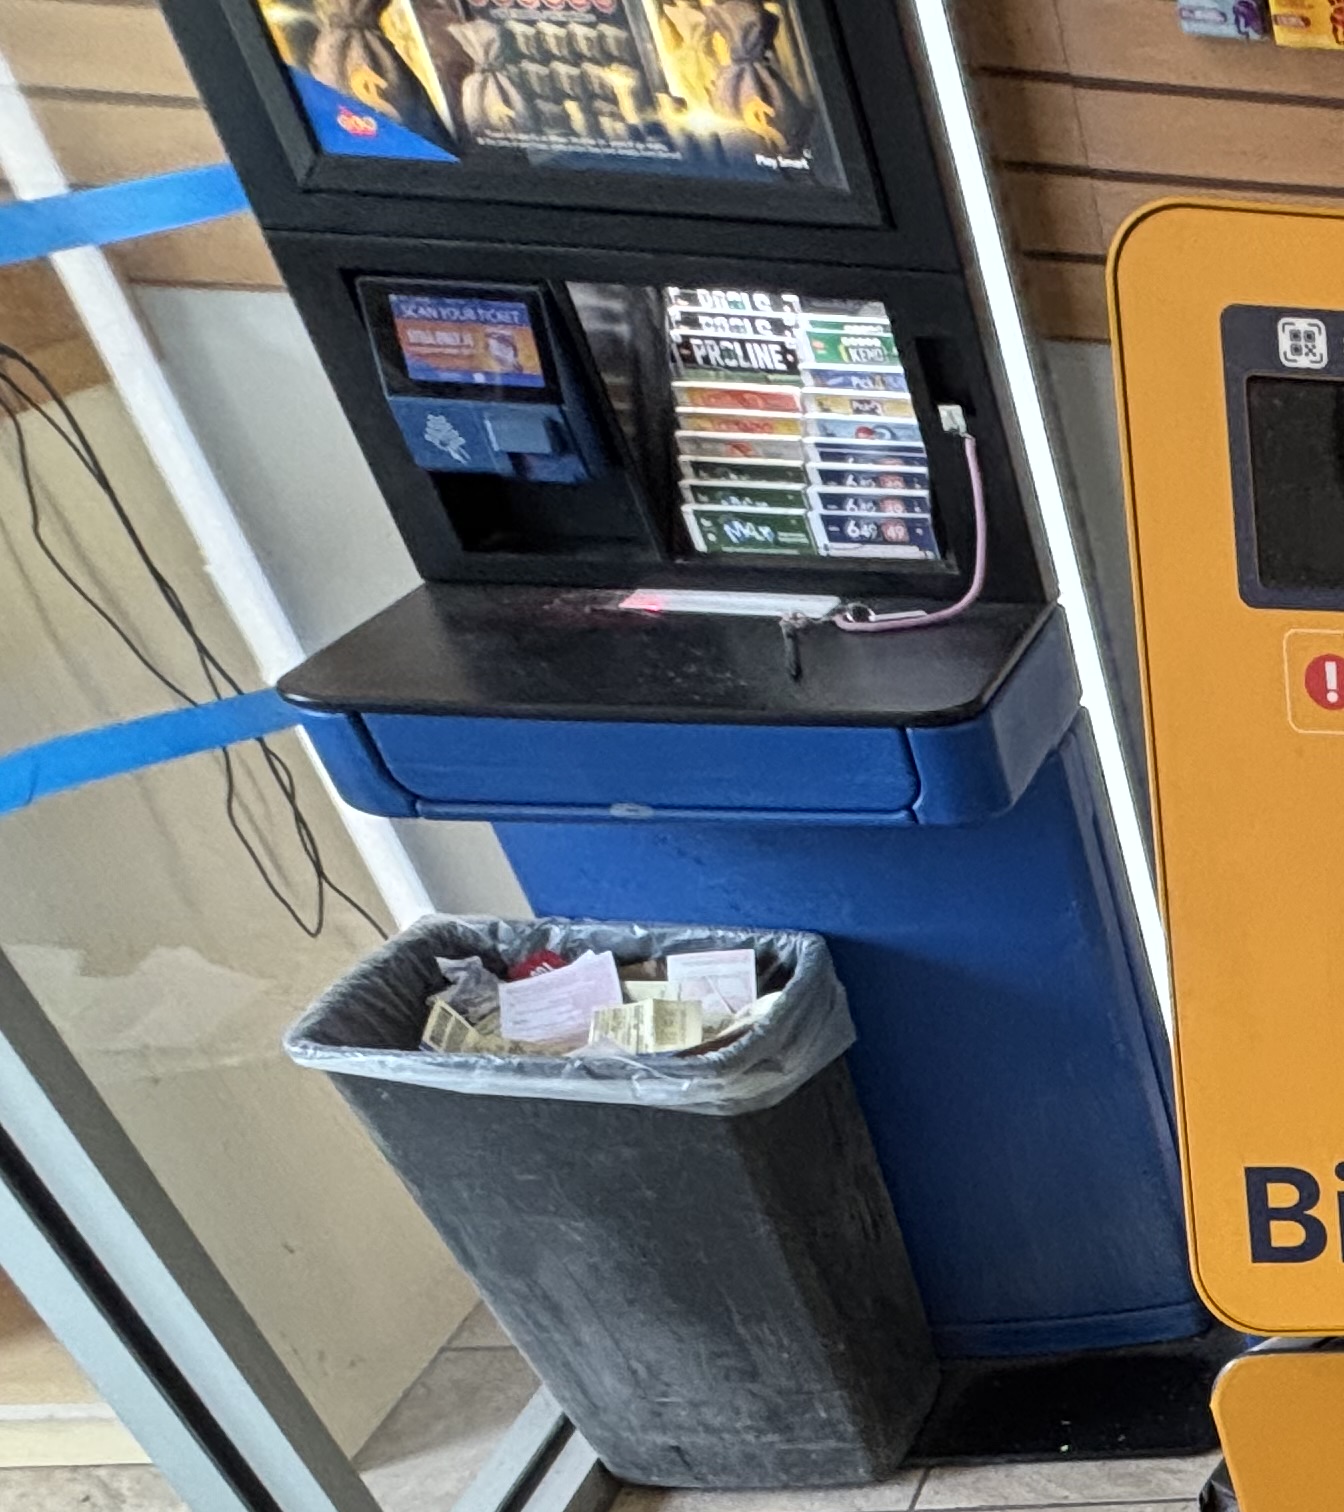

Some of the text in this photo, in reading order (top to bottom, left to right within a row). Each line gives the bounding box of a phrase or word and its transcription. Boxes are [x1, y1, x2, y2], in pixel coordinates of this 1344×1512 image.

[401, 304, 520, 323] SCAN YOUR TICKET
